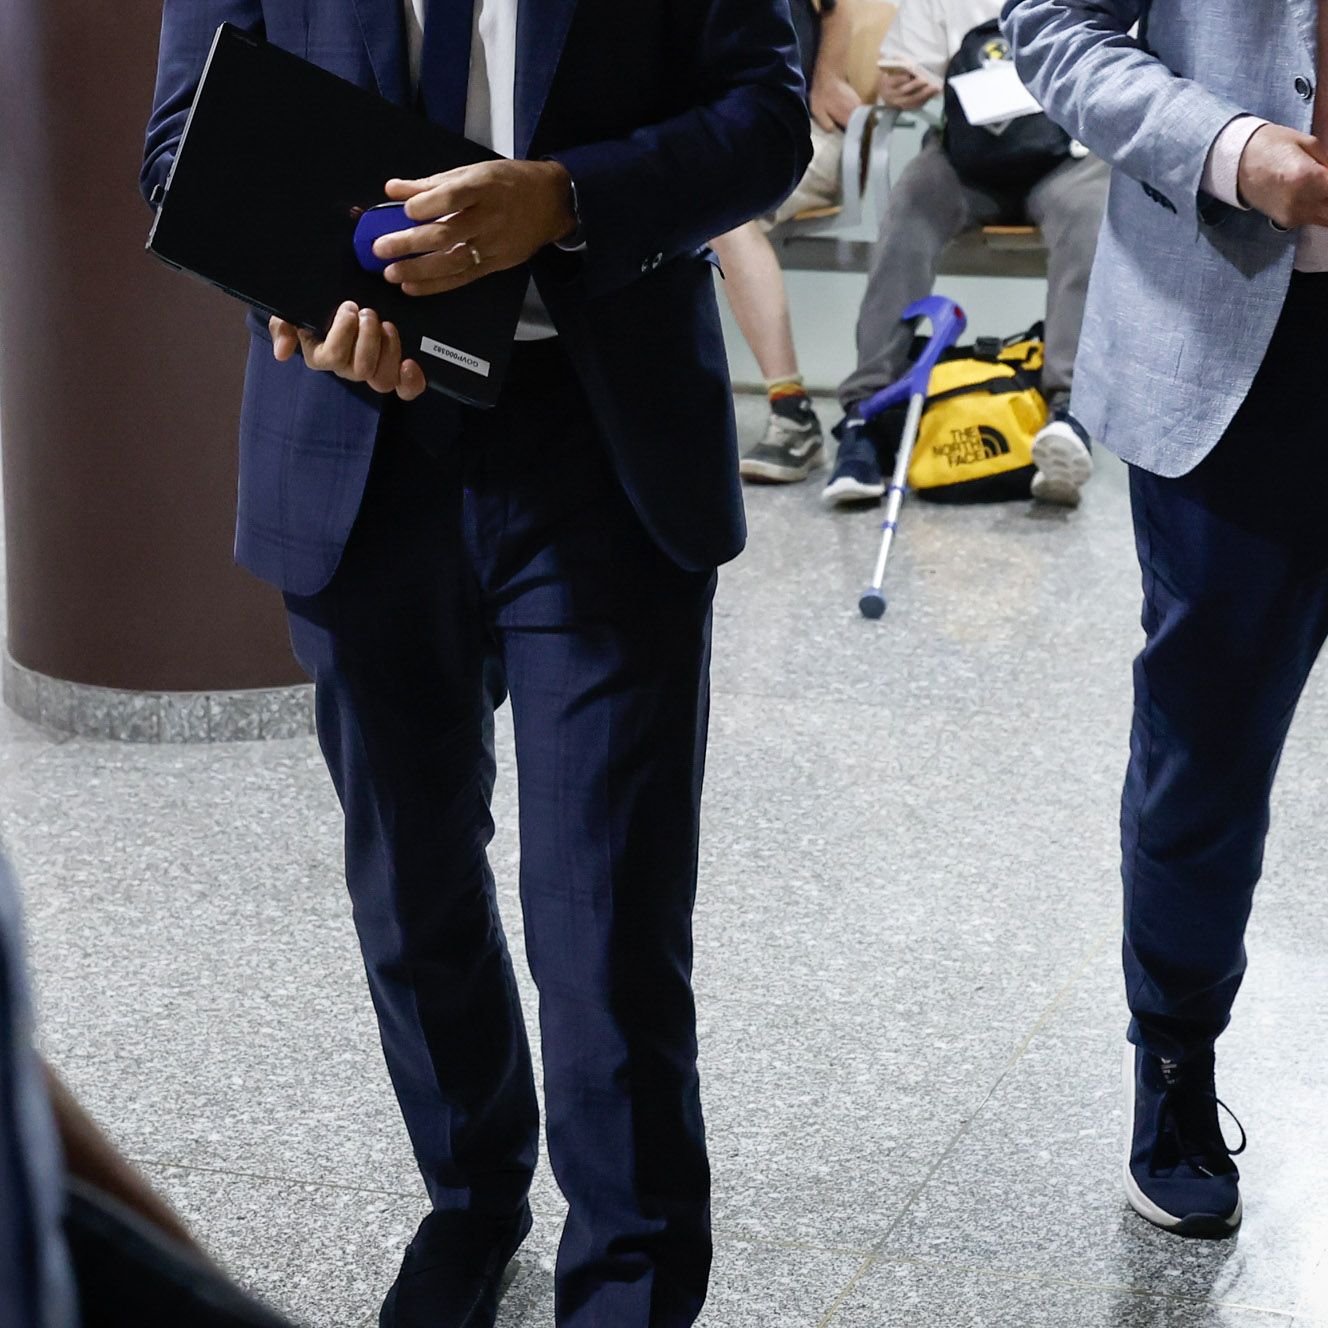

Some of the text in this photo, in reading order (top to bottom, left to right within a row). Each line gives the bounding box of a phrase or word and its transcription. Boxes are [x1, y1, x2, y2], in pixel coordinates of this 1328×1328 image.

[950, 426, 980, 444] THE
[933, 437, 982, 456] NORTH
[947, 451, 985, 468] FACE
